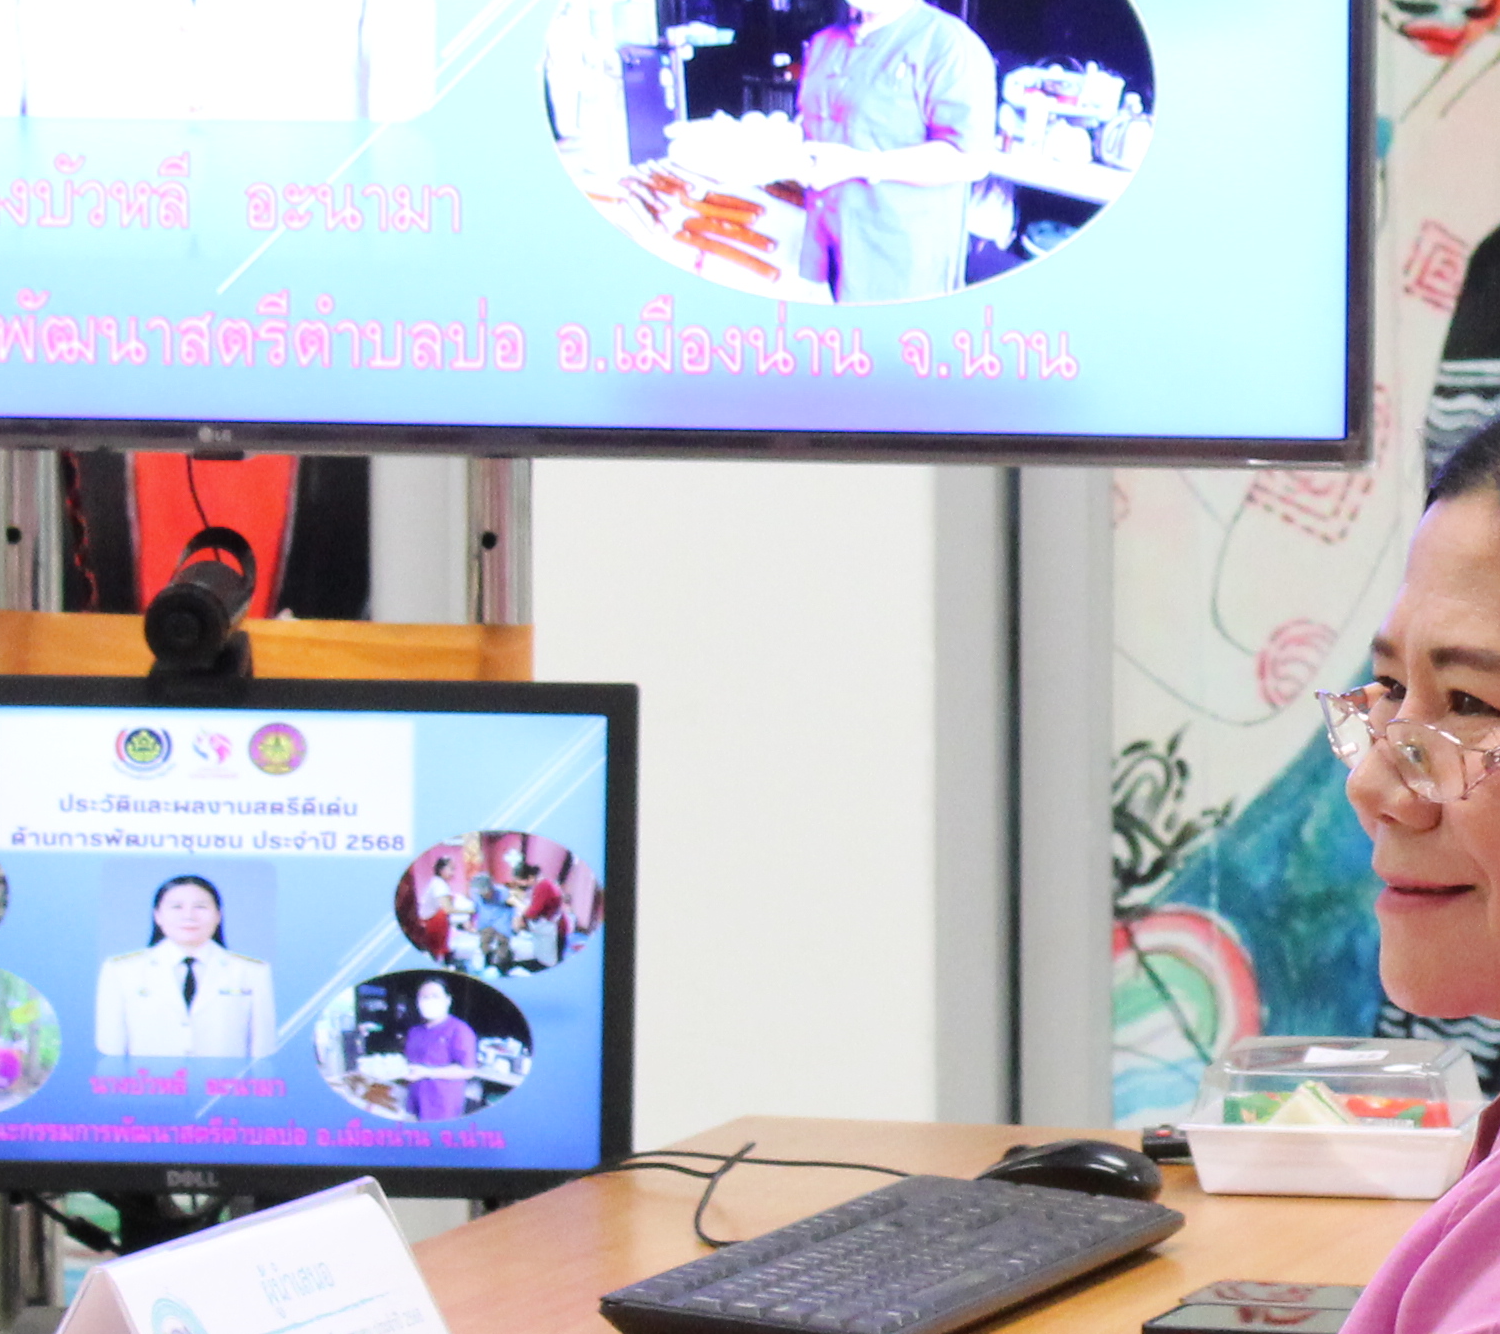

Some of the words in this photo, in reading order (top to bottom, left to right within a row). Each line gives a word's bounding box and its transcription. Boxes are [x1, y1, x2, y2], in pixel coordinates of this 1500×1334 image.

[245, 180, 463, 234] อะนามา
[557, 295, 874, 379] อ.เมืองน่าน
[900, 308, 1080, 381] จ.น่าน
[58, 793, 359, 818] ประวัติและผลงานสตรีดีเด่น
[253, 830, 338, 852] ประจำปี
[346, 834, 406, 852] 2568
[166, 1170, 219, 1187] DELL
